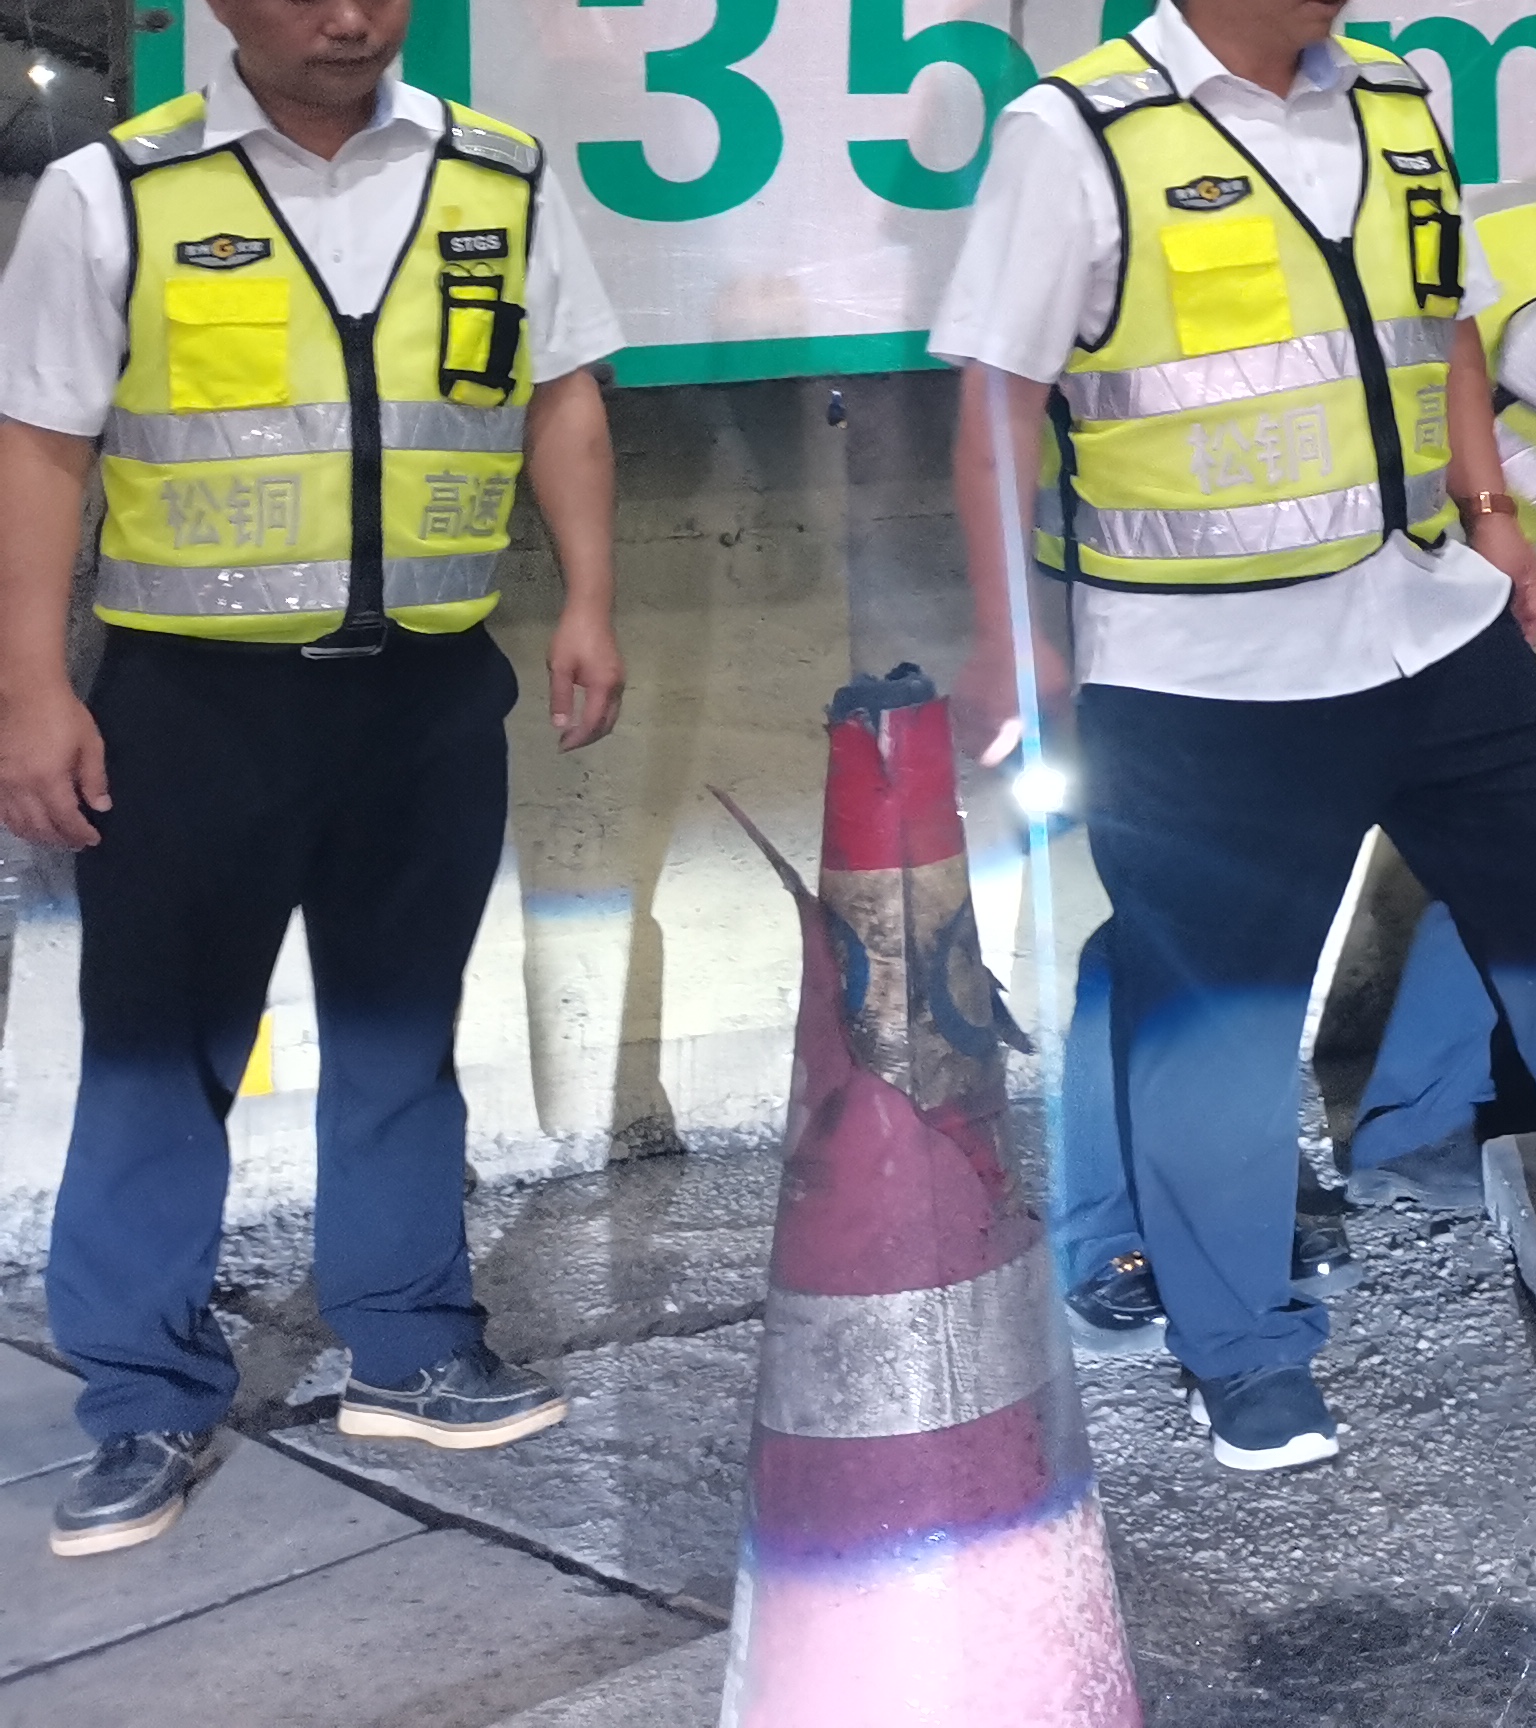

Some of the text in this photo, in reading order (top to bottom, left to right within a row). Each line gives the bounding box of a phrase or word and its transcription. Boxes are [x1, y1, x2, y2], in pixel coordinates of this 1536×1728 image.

[450, 234, 501, 253] STGS
[1187, 403, 1333, 496] 松铜
[160, 468, 514, 550] 松铜 高速
